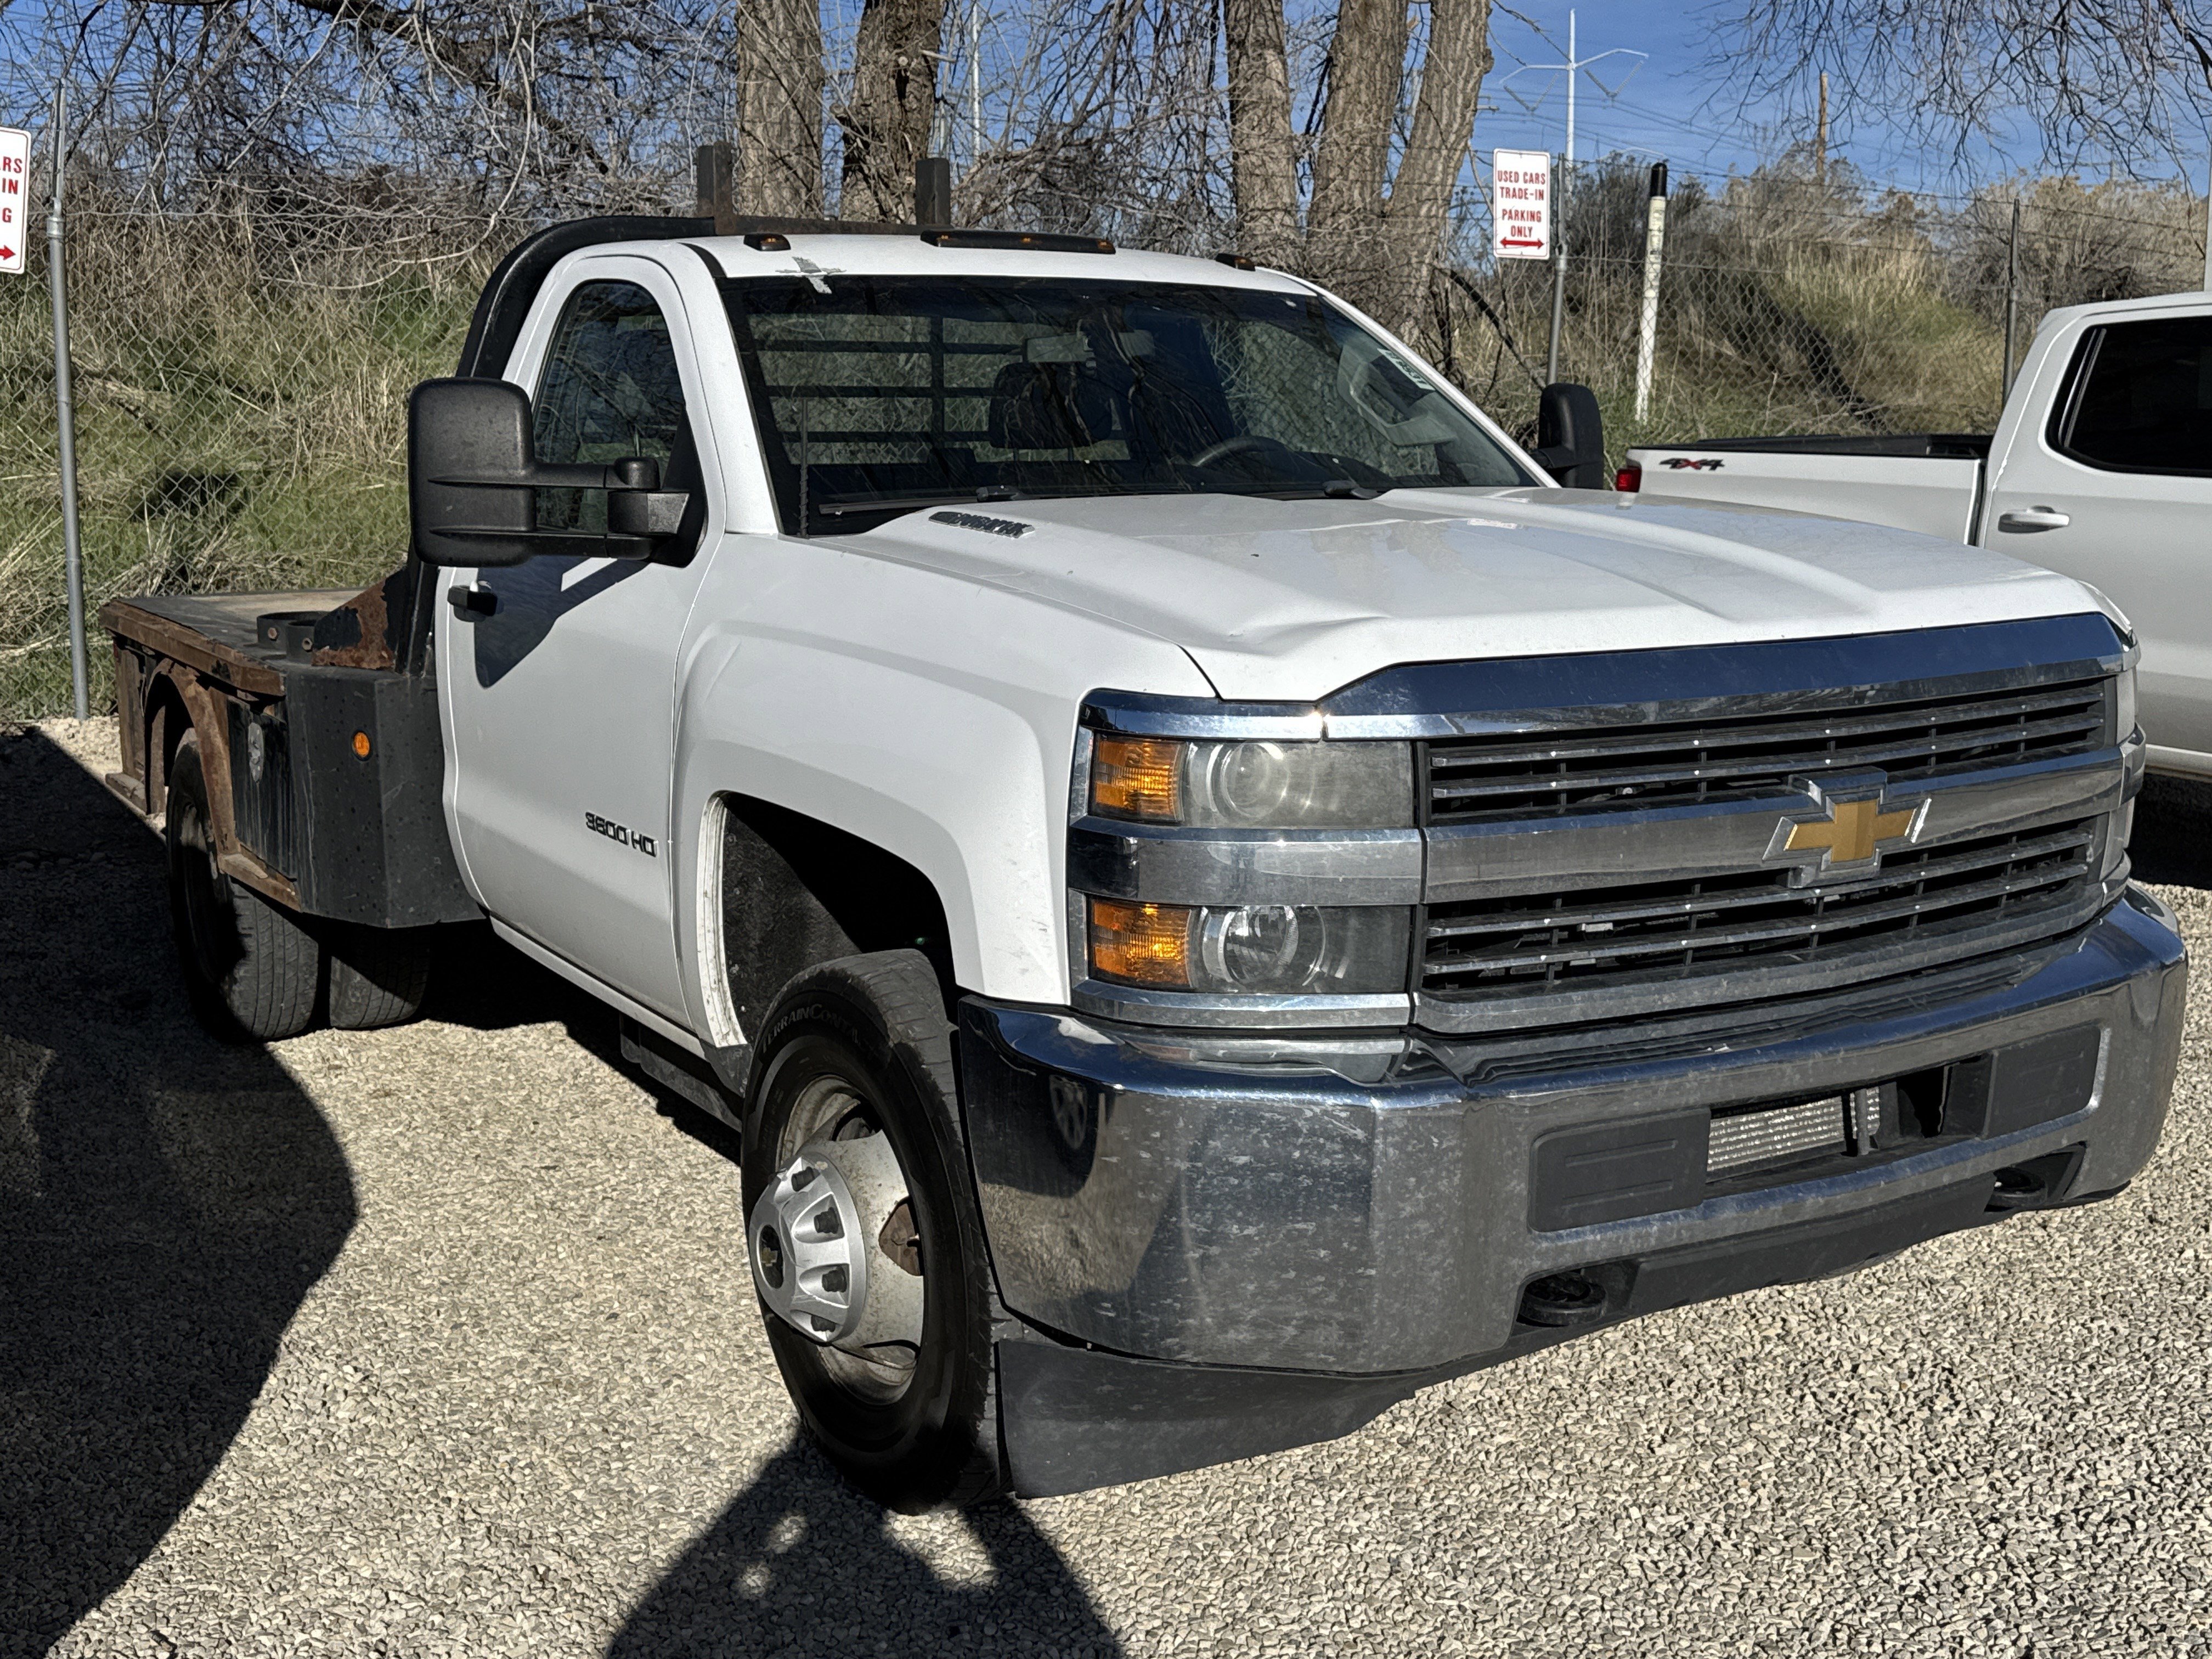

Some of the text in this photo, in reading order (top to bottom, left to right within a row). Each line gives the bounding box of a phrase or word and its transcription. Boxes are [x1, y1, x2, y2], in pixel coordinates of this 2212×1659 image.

[0, 156, 22, 173] RS
[1497, 170, 1546, 185] USED CARS
[1499, 187, 1544, 201] TRADE-IN
[1502, 208, 1542, 223] PARKING
[1510, 225, 1533, 238] ONLY
[631, 831, 658, 857] HD
